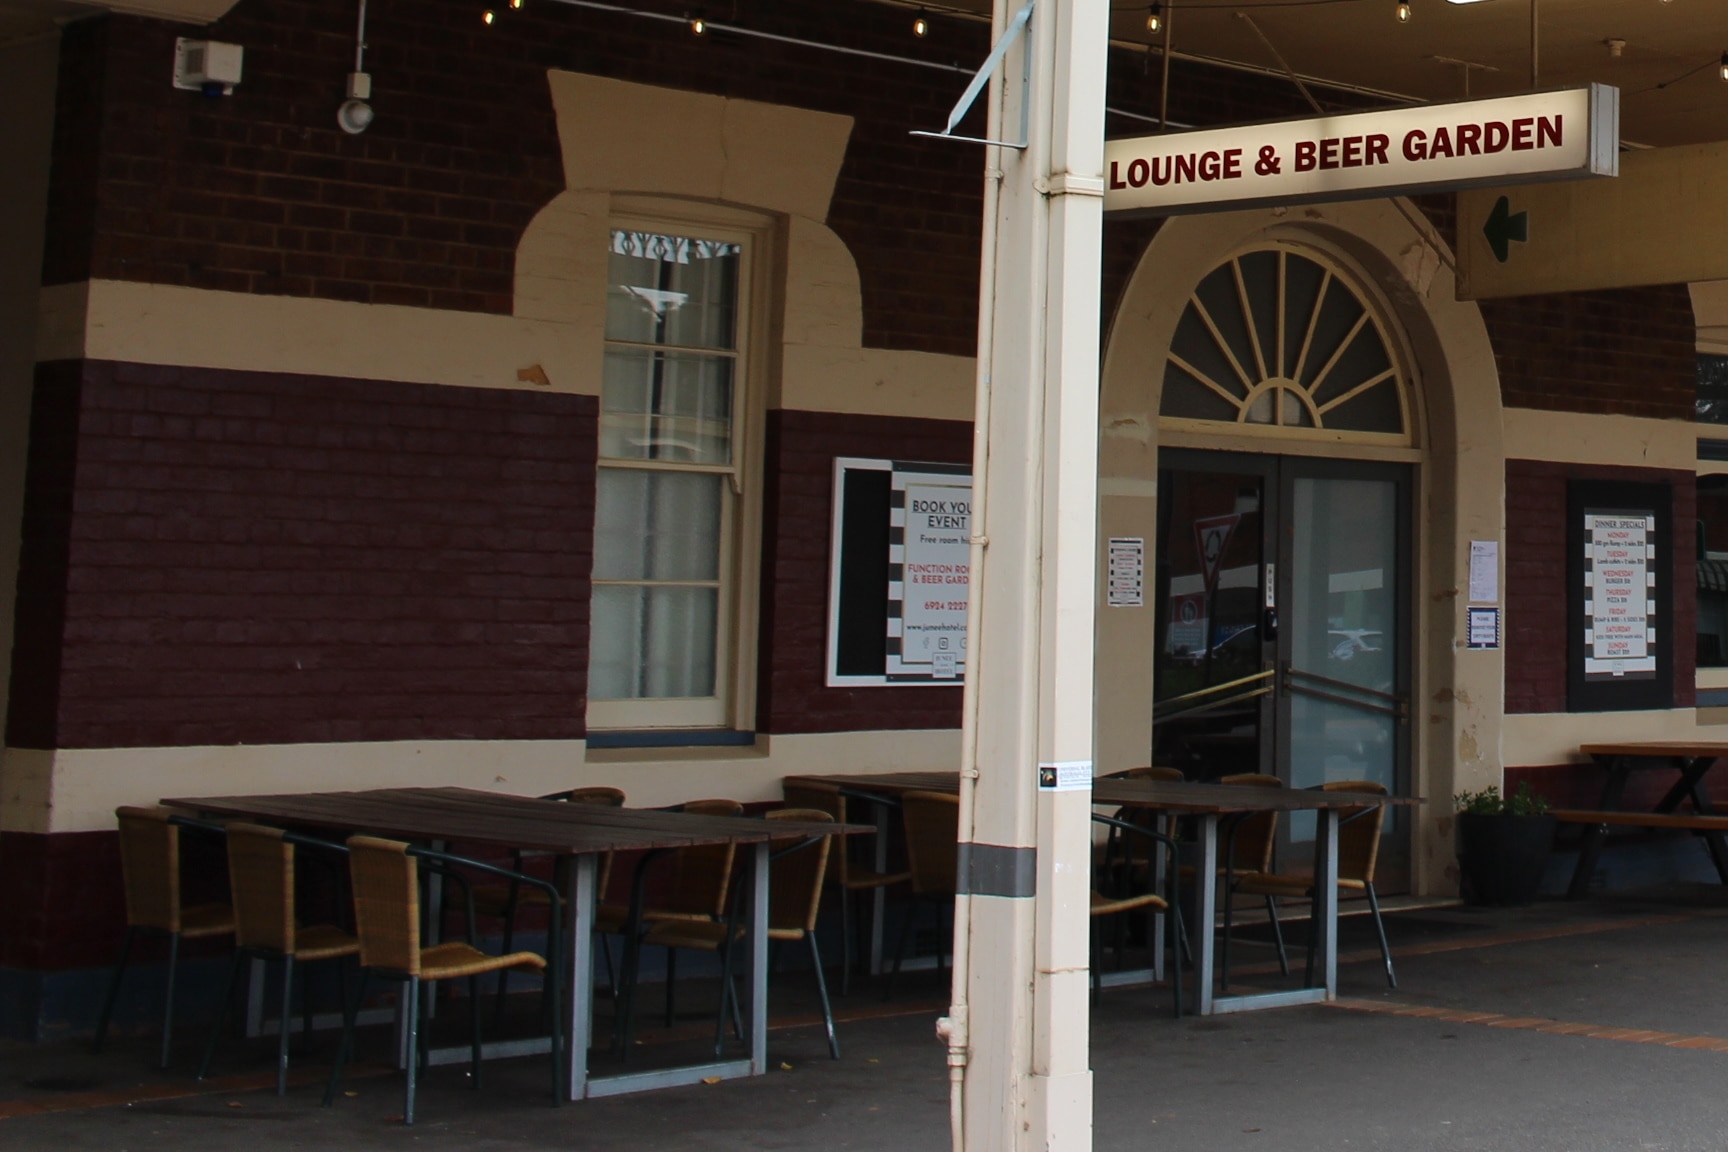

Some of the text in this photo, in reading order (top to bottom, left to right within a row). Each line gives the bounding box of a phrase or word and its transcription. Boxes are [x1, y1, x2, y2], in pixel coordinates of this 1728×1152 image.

[1109, 114, 1564, 191] LOUNGE & BEER GARDEN
[912, 500, 973, 514] BOOK YOU
[928, 515, 967, 528] EVENT
[1595, 520, 1645, 529] DINNER SPECIALS
[920, 534, 937, 544] Free
[939, 536, 958, 544] room
[908, 564, 952, 574] FUNCTION
[912, 575, 918, 584] &
[922, 575, 943, 584] BEER
[924, 601, 945, 611] 6924
